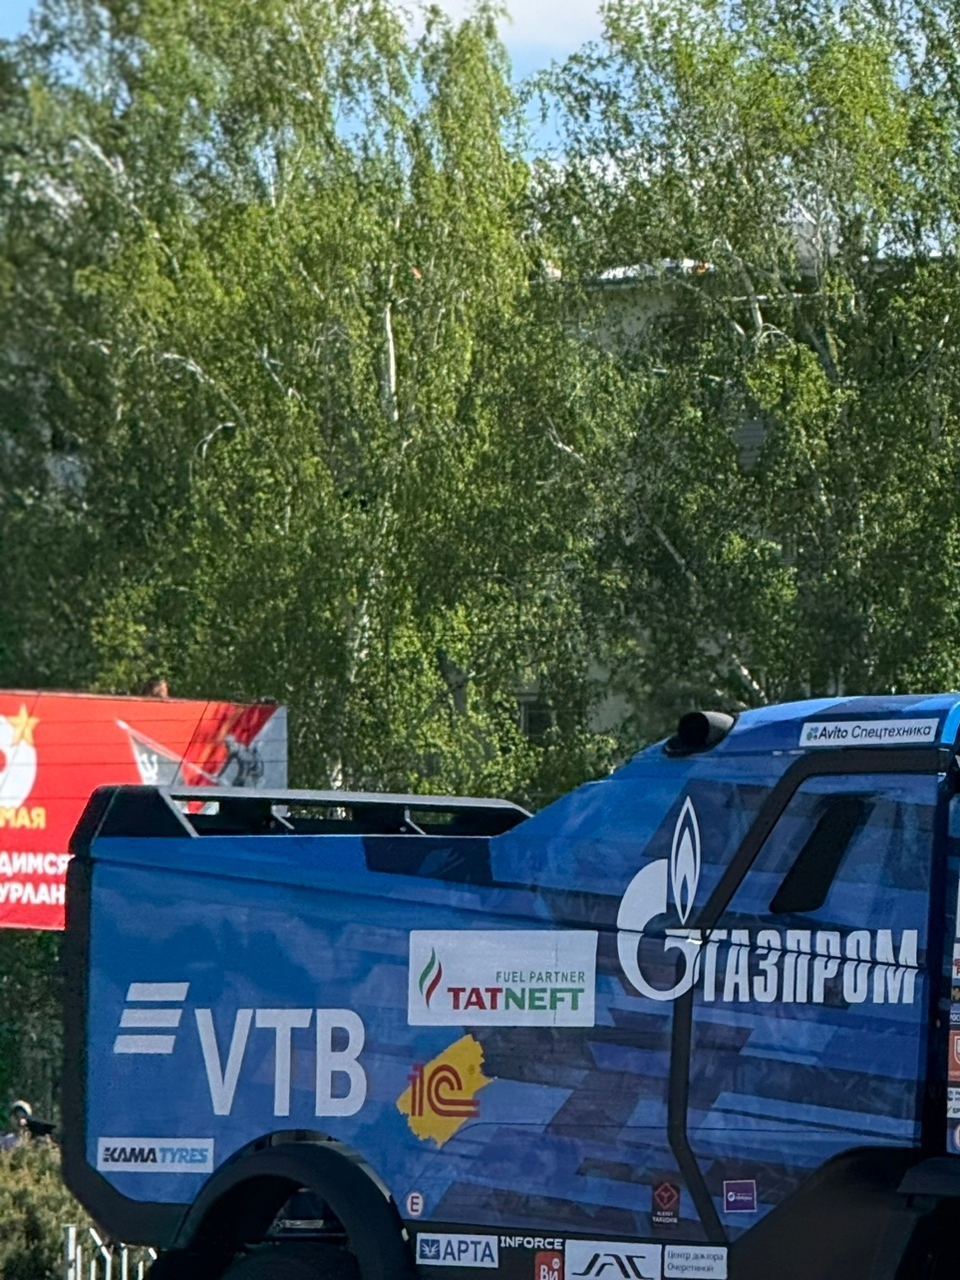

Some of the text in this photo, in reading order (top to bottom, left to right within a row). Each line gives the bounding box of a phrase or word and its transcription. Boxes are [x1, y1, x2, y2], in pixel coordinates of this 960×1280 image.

[819, 725, 932, 740] Avito Спецтехника
[704, 929, 919, 1004] ГАЗПРОМ
[495, 970, 585, 984] FUEL PARTNER
[447, 987, 584, 1011] TATNEFT
[194, 1008, 367, 1117] VTB
[410, 1195, 420, 1213] E
[500, 1236, 563, 1249] INFORCE
